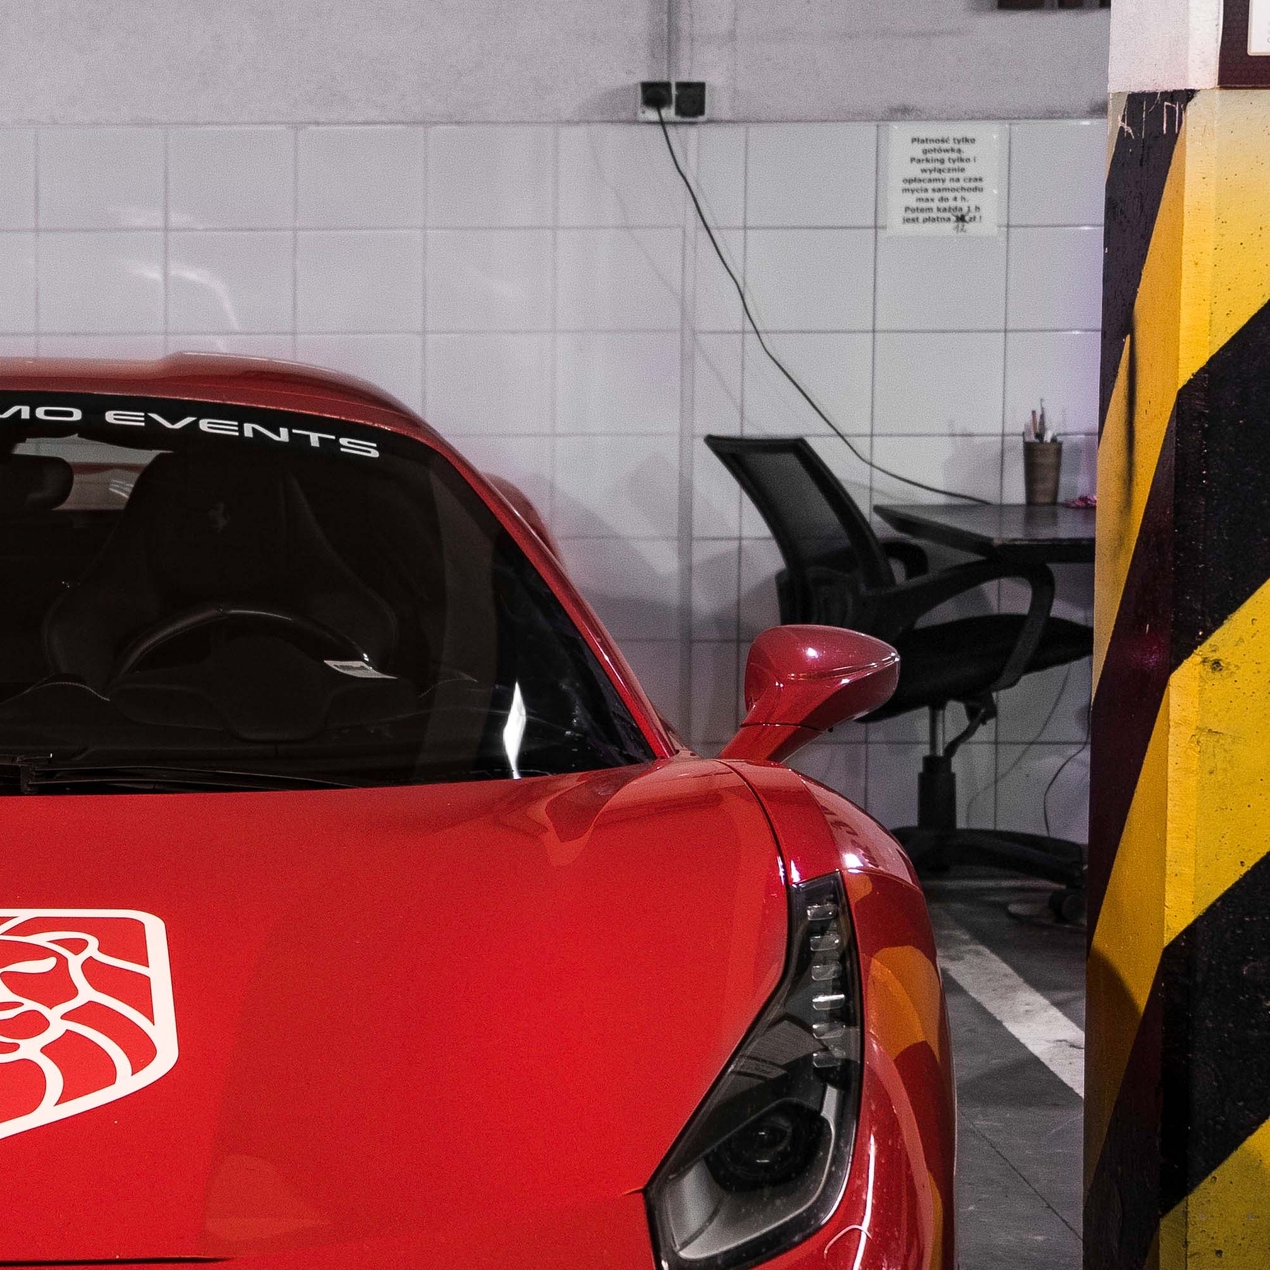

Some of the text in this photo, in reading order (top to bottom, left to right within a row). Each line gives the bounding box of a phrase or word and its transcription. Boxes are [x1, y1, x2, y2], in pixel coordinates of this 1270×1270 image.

[952, 136, 976, 145] tylko
[910, 156, 945, 165] Parking
[947, 156, 971, 165] tylko
[920, 166, 966, 175] wyłącznie
[902, 177, 947, 185] opłacamy
[901, 185, 984, 194] mycia samochodu
[937, 195, 950, 203] do
[904, 206, 934, 214] Potem
[936, 205, 963, 213] każda
[902, 216, 920, 224] jest
[922, 216, 952, 224] płatna
[105, 410, 380, 458] EVENTS
